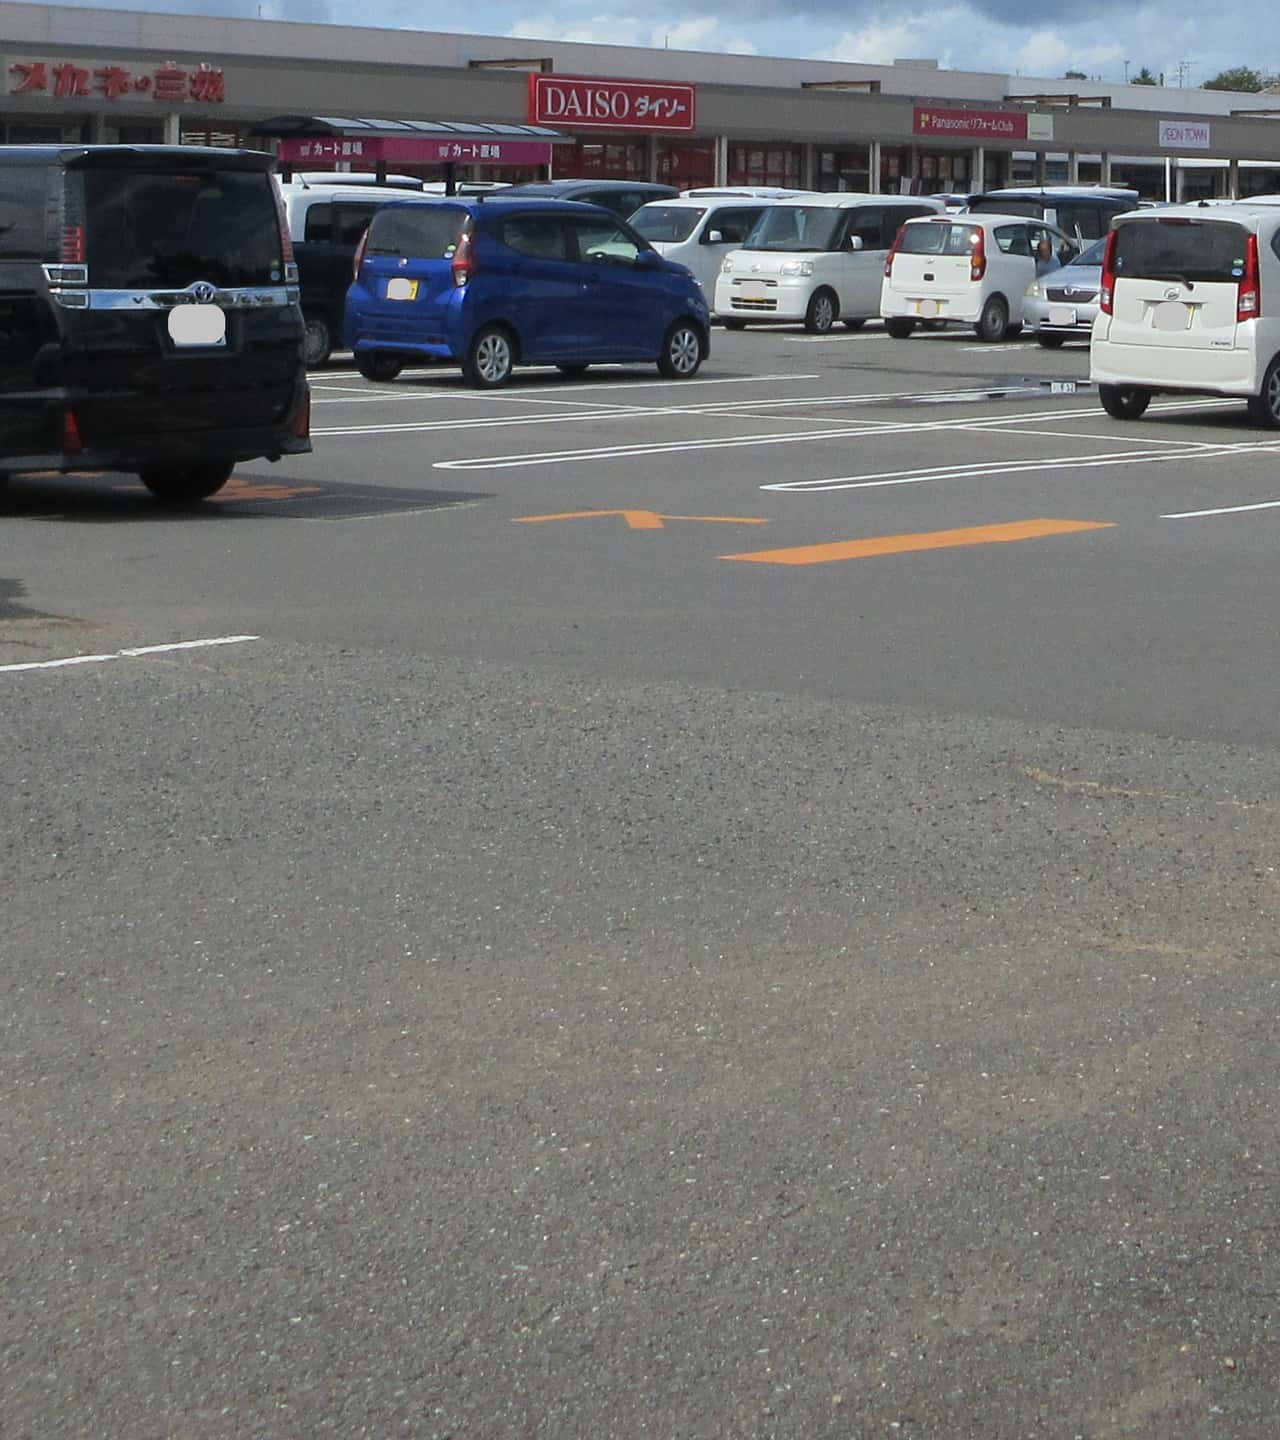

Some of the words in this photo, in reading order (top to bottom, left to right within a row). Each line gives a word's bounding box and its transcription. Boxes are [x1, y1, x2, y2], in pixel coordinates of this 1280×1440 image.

[545, 87, 630, 119] DAISO
[634, 95, 687, 118] ダイソー
[313, 142, 363, 156] カート置場
[452, 143, 501, 158] カート置場
